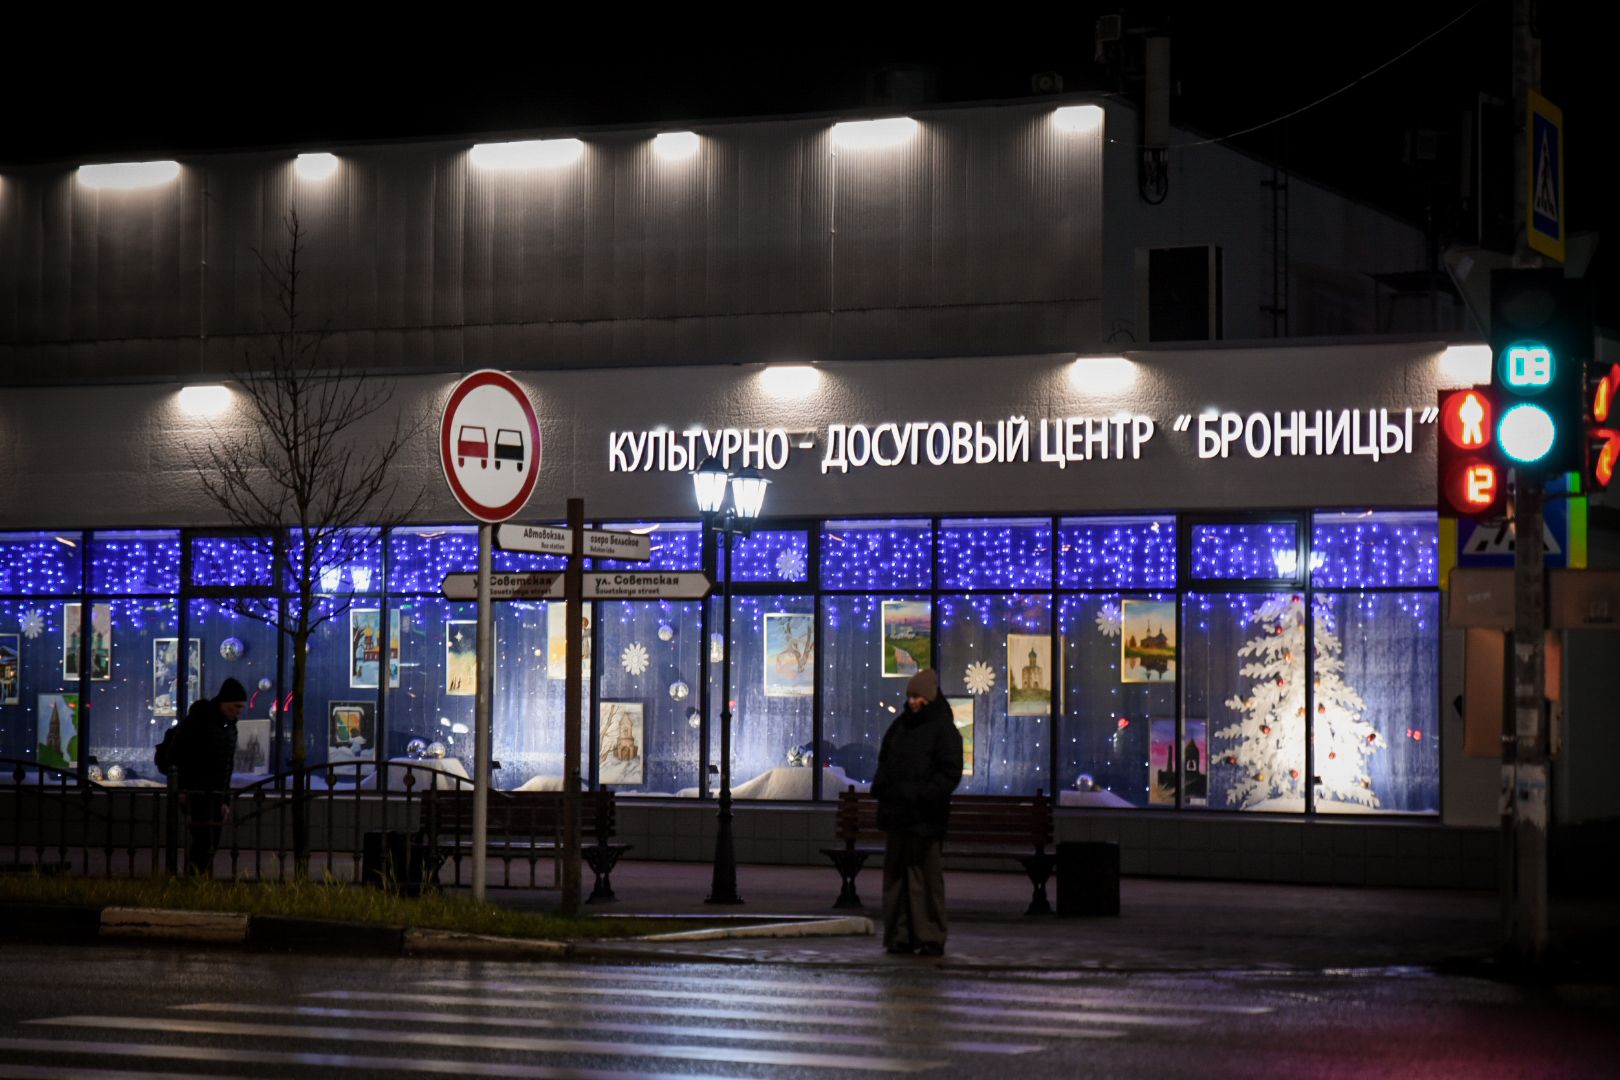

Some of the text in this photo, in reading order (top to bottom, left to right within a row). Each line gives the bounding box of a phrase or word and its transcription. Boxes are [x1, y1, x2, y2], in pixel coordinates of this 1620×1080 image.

[1508, 347, 1550, 386] 08
[609, 428, 789, 472] КУЛЬТУРНО
[821, 417, 1029, 474] ДОСУГОВЫЙ
[1040, 415, 1154, 469] ЦЕНТР
[523, 528, 565, 541] Автовокзал
[590, 535, 639, 547] озеро Бельское
[490, 575, 552, 586] Советская
[595, 575, 679, 587] ул. Советская
[638, 587, 660, 595] street
